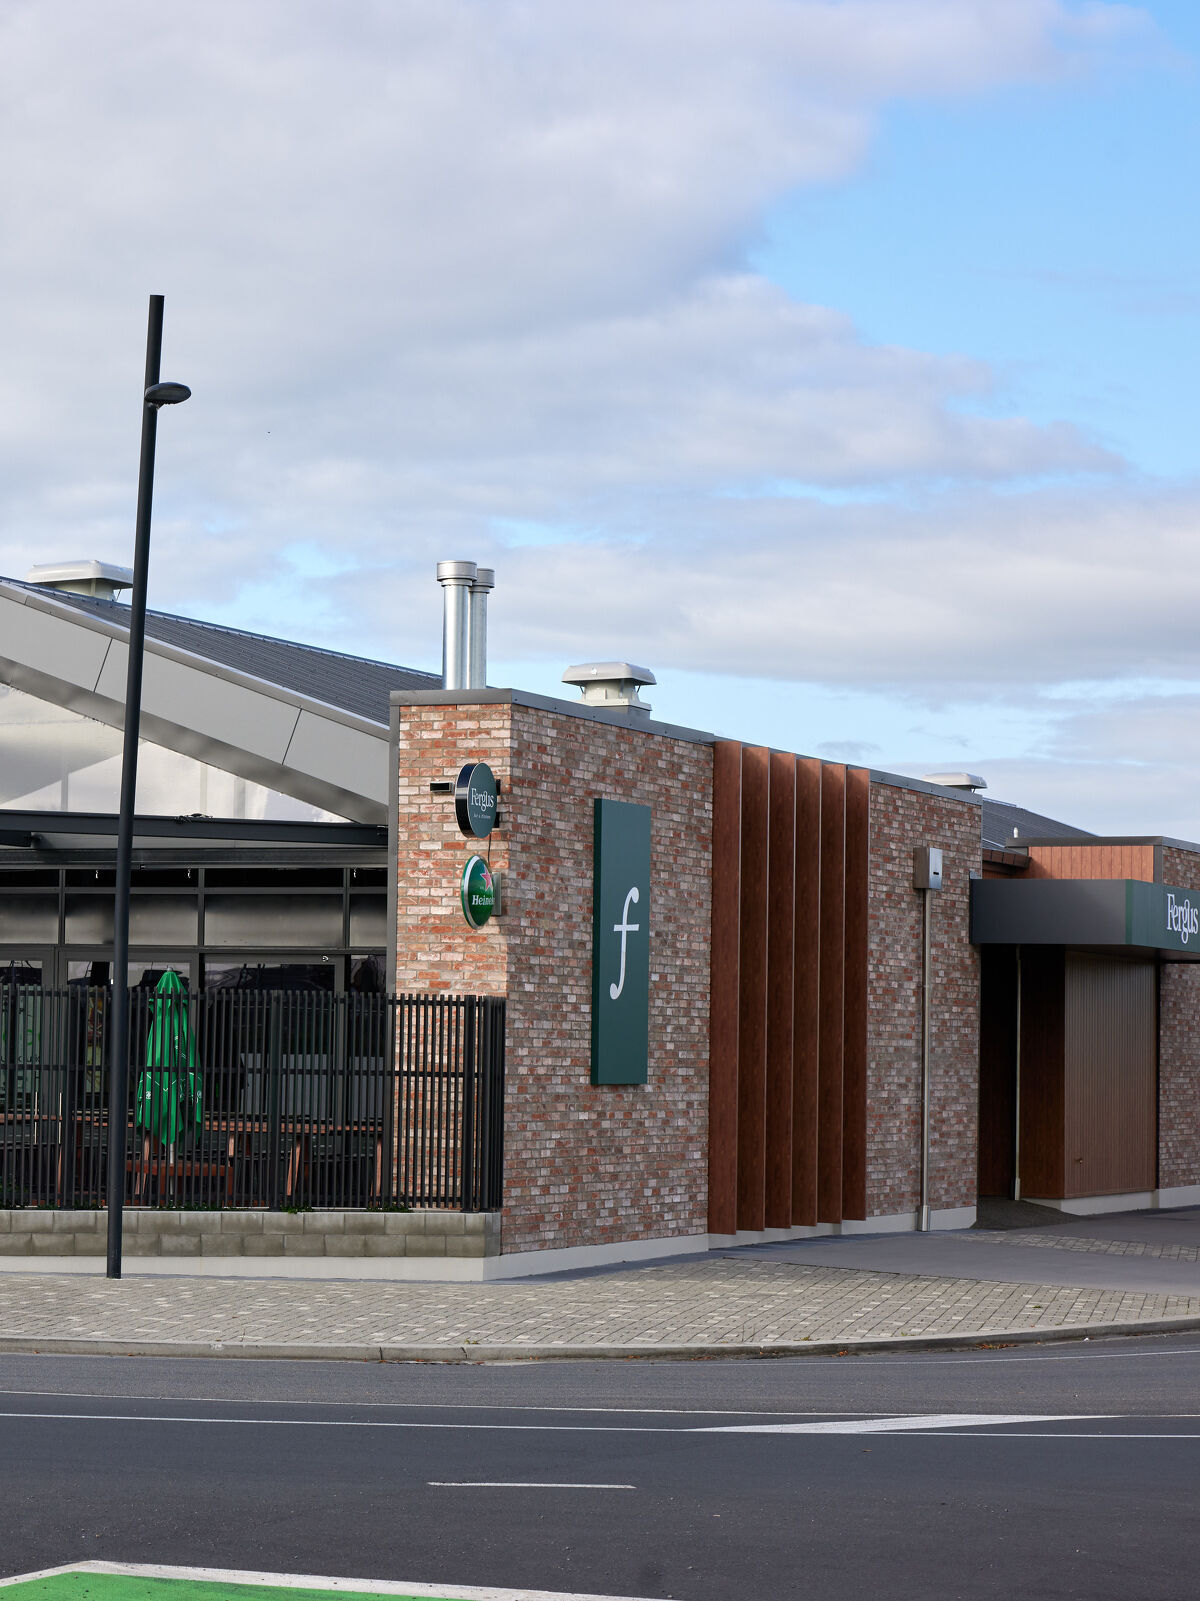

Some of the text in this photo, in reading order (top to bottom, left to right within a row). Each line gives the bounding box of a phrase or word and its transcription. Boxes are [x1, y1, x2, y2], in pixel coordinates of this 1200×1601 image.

[471, 788, 494, 812] Fergus
[609, 886, 640, 1001] f
[1166, 893, 1199, 944] Fergus
